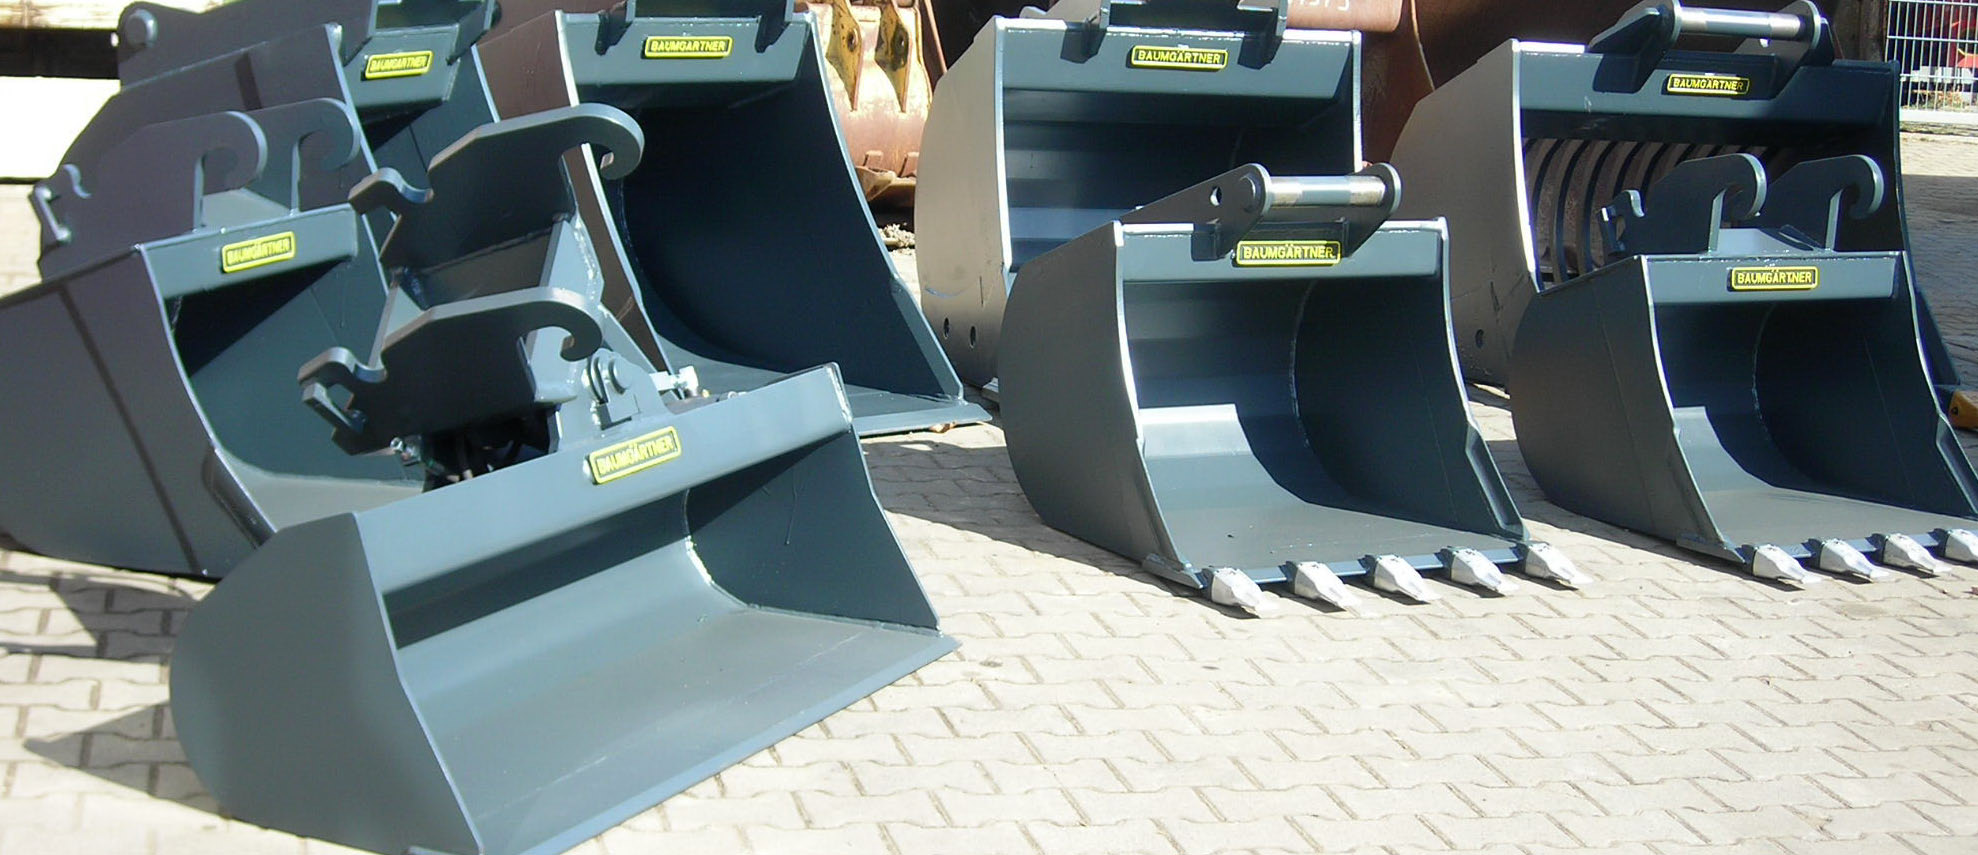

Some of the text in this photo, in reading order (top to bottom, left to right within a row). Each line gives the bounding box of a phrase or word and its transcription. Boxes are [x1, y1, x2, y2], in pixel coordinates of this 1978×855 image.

[1138, 48, 1221, 64] BAUMGÄRTNER
[1673, 77, 1744, 91] BAUMGÄRTNER
[1243, 243, 1335, 260] BAUMGÄRTNER
[1737, 269, 1812, 284] BAUMGÄRTNER
